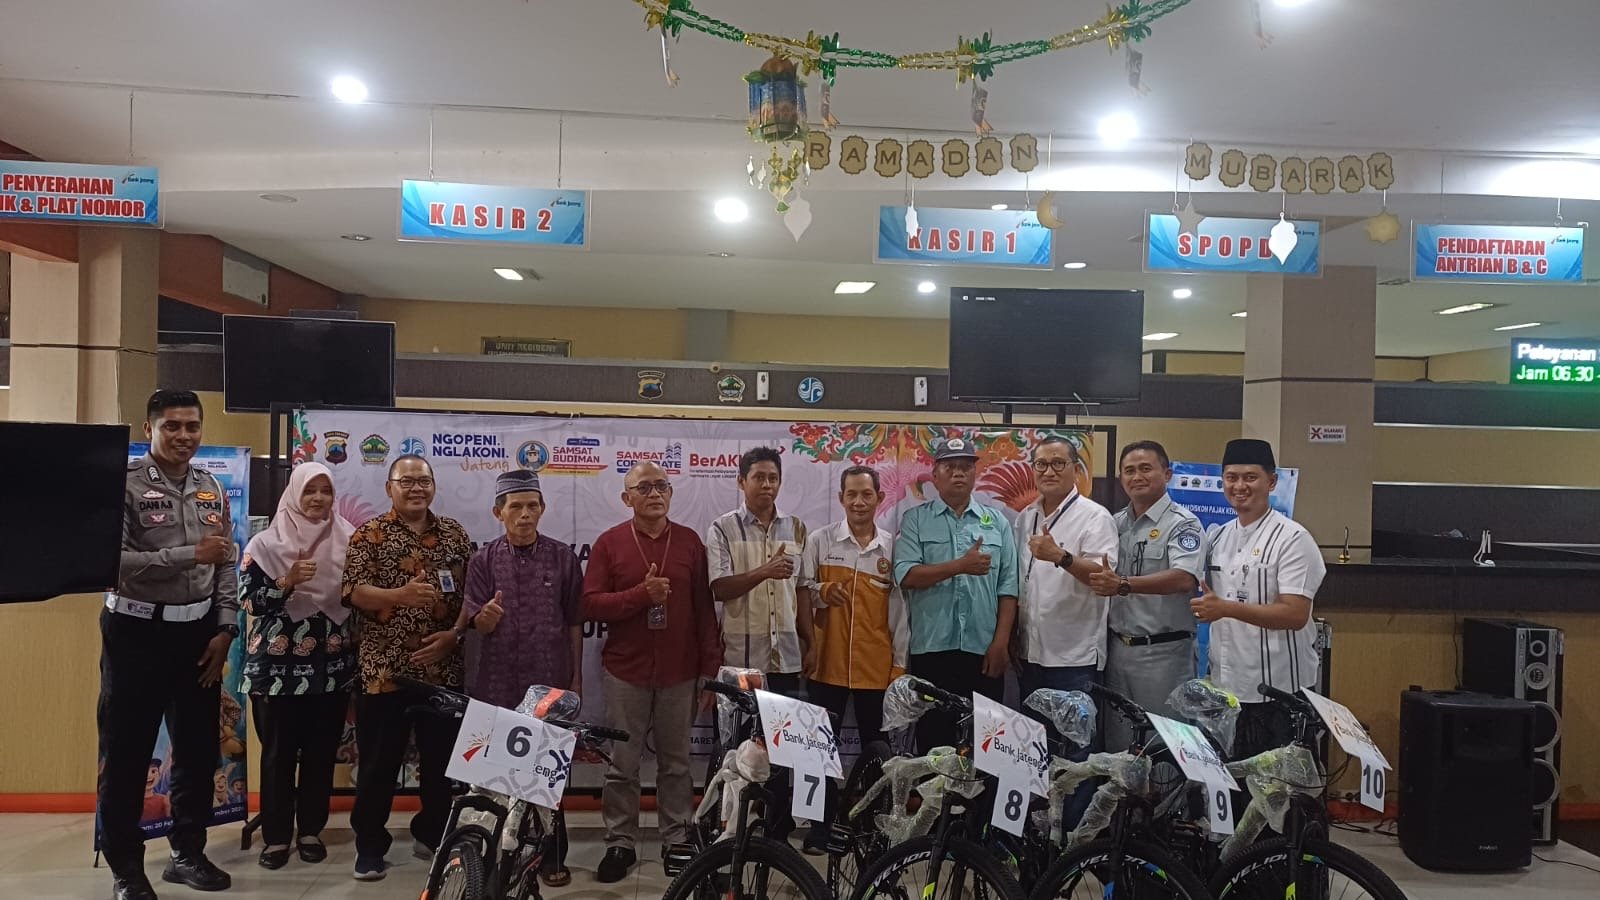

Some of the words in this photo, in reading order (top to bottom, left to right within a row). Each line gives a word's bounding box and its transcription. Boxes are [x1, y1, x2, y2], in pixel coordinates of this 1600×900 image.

[808, 141, 1034, 166] RAMADAN
[1190, 153, 1388, 184] MUBARAK
[3, 174, 113, 195] PENYERAHAN
[20, 200, 33, 212] &
[38, 198, 77, 214] PLAT
[81, 200, 144, 217] NOMOR
[430, 203, 526, 229] KASIR
[538, 210, 552, 231] 2
[908, 228, 995, 252] KASIR
[1005, 232, 1016, 253] 1
[1437, 238, 1545, 256] PENDAFTARAN
[1436, 257, 1503, 273] ANTRIAN
[1507, 259, 1518, 273] B
[1521, 261, 1533, 274] &
[1537, 261, 1548, 274] C
[1517, 343, 1596, 364] Pelayanan
[1516, 364, 1549, 380] Jam
[1551, 365, 1594, 382] 06.30
[432, 433, 501, 446] NGOPENI.
[432, 445, 509, 459] NGLAKONI.
[552, 446, 593, 455] SAMSAT
[552, 454, 600, 464] BUDIMAN
[616, 451, 665, 460] SAMSAT
[460, 456, 510, 473] Jateng
[506, 725, 533, 757] 6
[783, 729, 804, 745] Bank
[994, 738, 1015, 756] Bank
[803, 774, 820, 806] 7
[1363, 764, 1384, 799] 10
[1005, 789, 1023, 821] 8
[1216, 790, 1228, 822] 9
